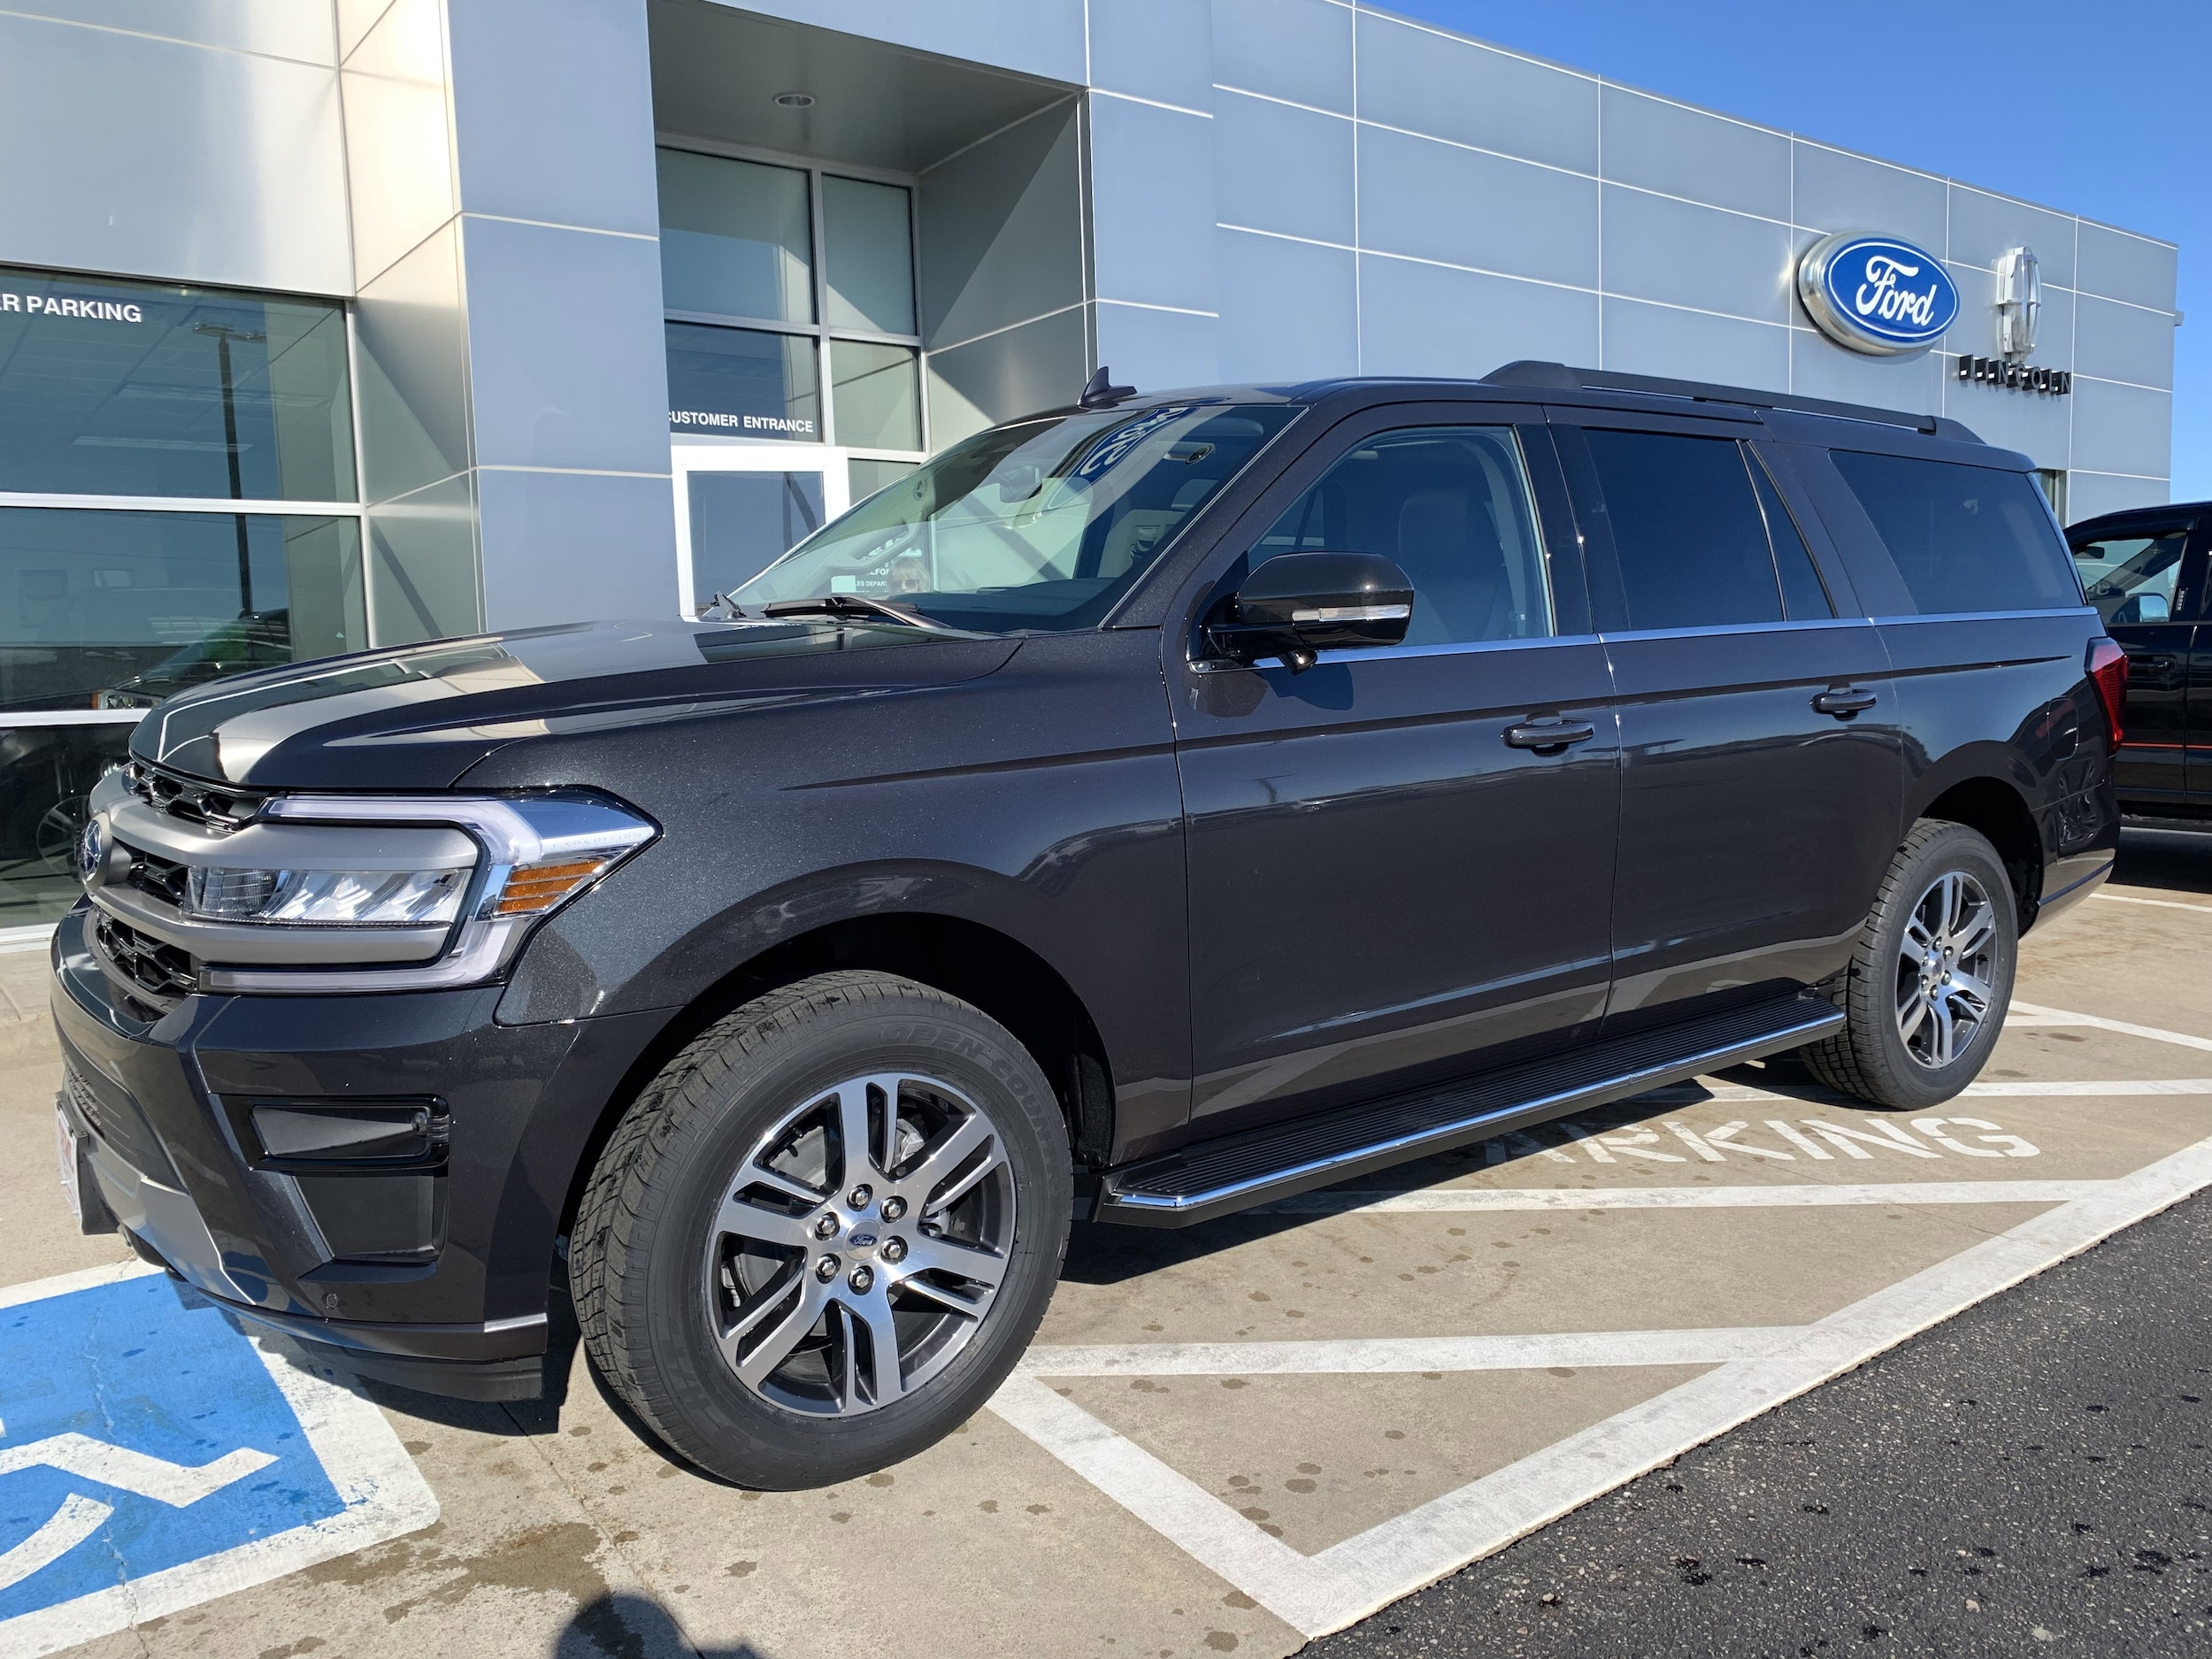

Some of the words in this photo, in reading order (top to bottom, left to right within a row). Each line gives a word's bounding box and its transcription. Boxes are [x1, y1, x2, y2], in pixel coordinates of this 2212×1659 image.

[0, 293, 20, 312] R
[27, 295, 142, 323] PARKING
[1855, 256, 1938, 326] Ford
[1959, 355, 2071, 395] LINCOLN
[743, 416, 813, 433] ENTRANCE
[880, 1024, 987, 1060] OPEN
[1486, 1117, 2040, 1164] ARKING
[853, 1235, 873, 1246] Ford
